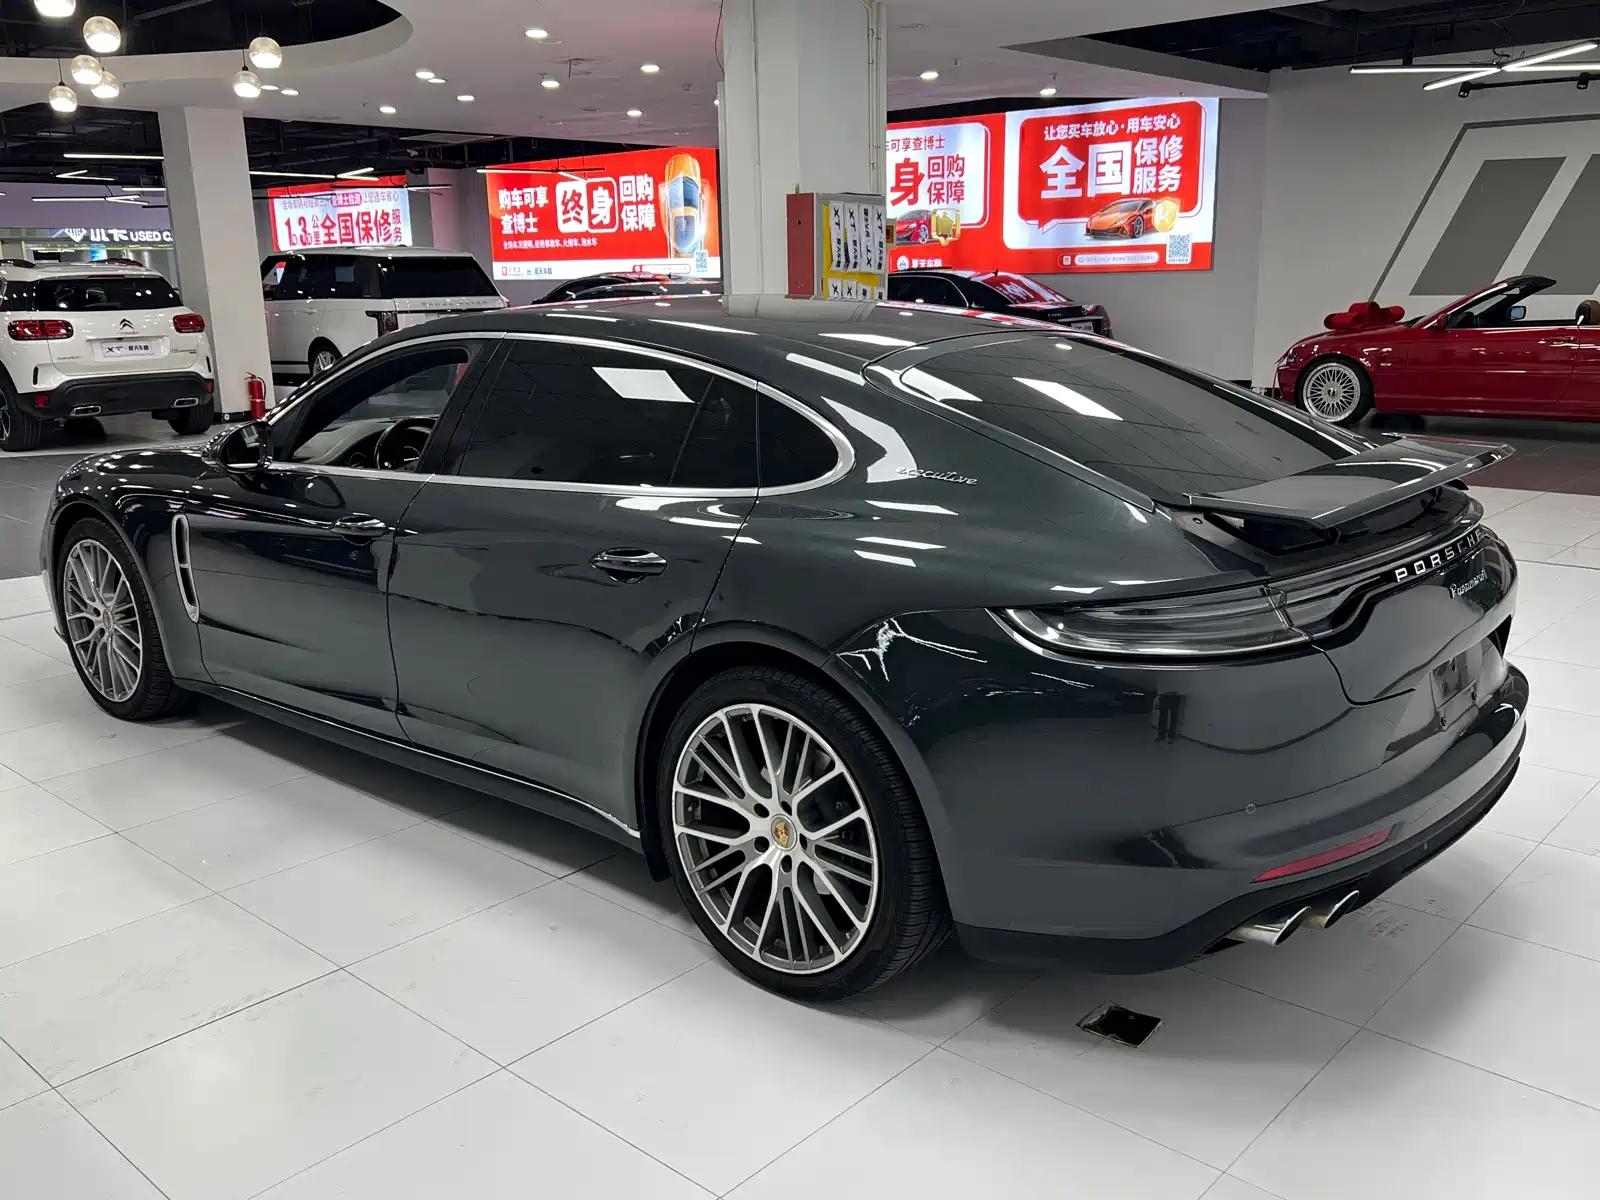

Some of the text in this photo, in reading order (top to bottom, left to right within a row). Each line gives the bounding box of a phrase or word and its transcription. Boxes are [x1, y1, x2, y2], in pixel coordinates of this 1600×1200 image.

[1043, 113, 1181, 141] 让您买车放心·用车安心
[1134, 135, 1183, 166] 保修
[927, 154, 965, 179] 回购
[1039, 141, 1132, 199] 全国
[1133, 165, 1182, 194] 服务
[619, 174, 654, 203] 回购
[890, 157, 925, 206] 身
[927, 180, 965, 205] 保障
[498, 185, 549, 210] 购车可享
[561, 186, 614, 225] 终身
[321, 209, 392, 245] 全国保修
[501, 211, 539, 235] 查博士
[620, 203, 656, 232] 保障
[129, 230, 161, 242] USED
